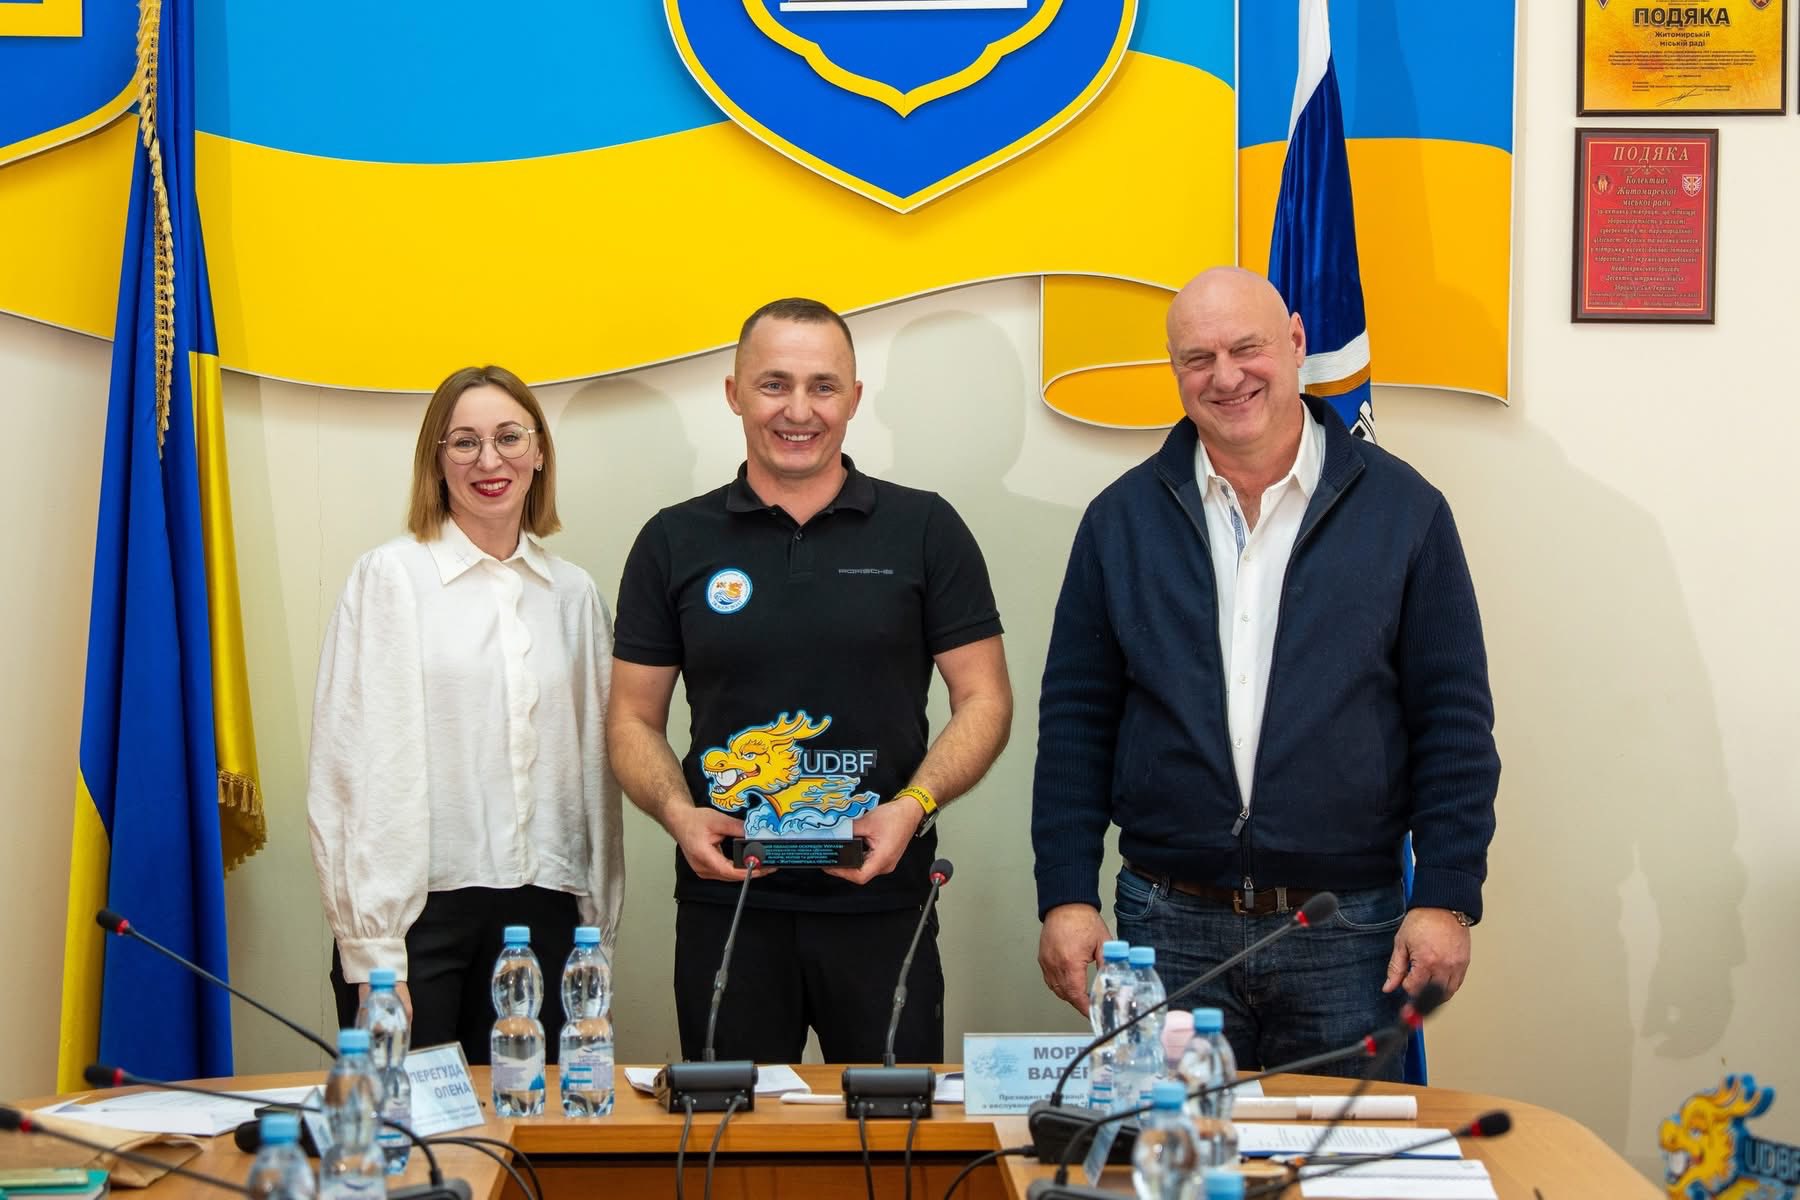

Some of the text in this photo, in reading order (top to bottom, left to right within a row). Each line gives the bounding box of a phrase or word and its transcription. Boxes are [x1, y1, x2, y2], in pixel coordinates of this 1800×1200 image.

[1634, 8, 1730, 27] ПОДЯКА
[1655, 31, 1711, 39] Житомирській
[1613, 146, 1689, 162] ПОДЯКА
[802, 752, 875, 774] UDBF
[434, 1082, 472, 1098] ОЛЕНА
